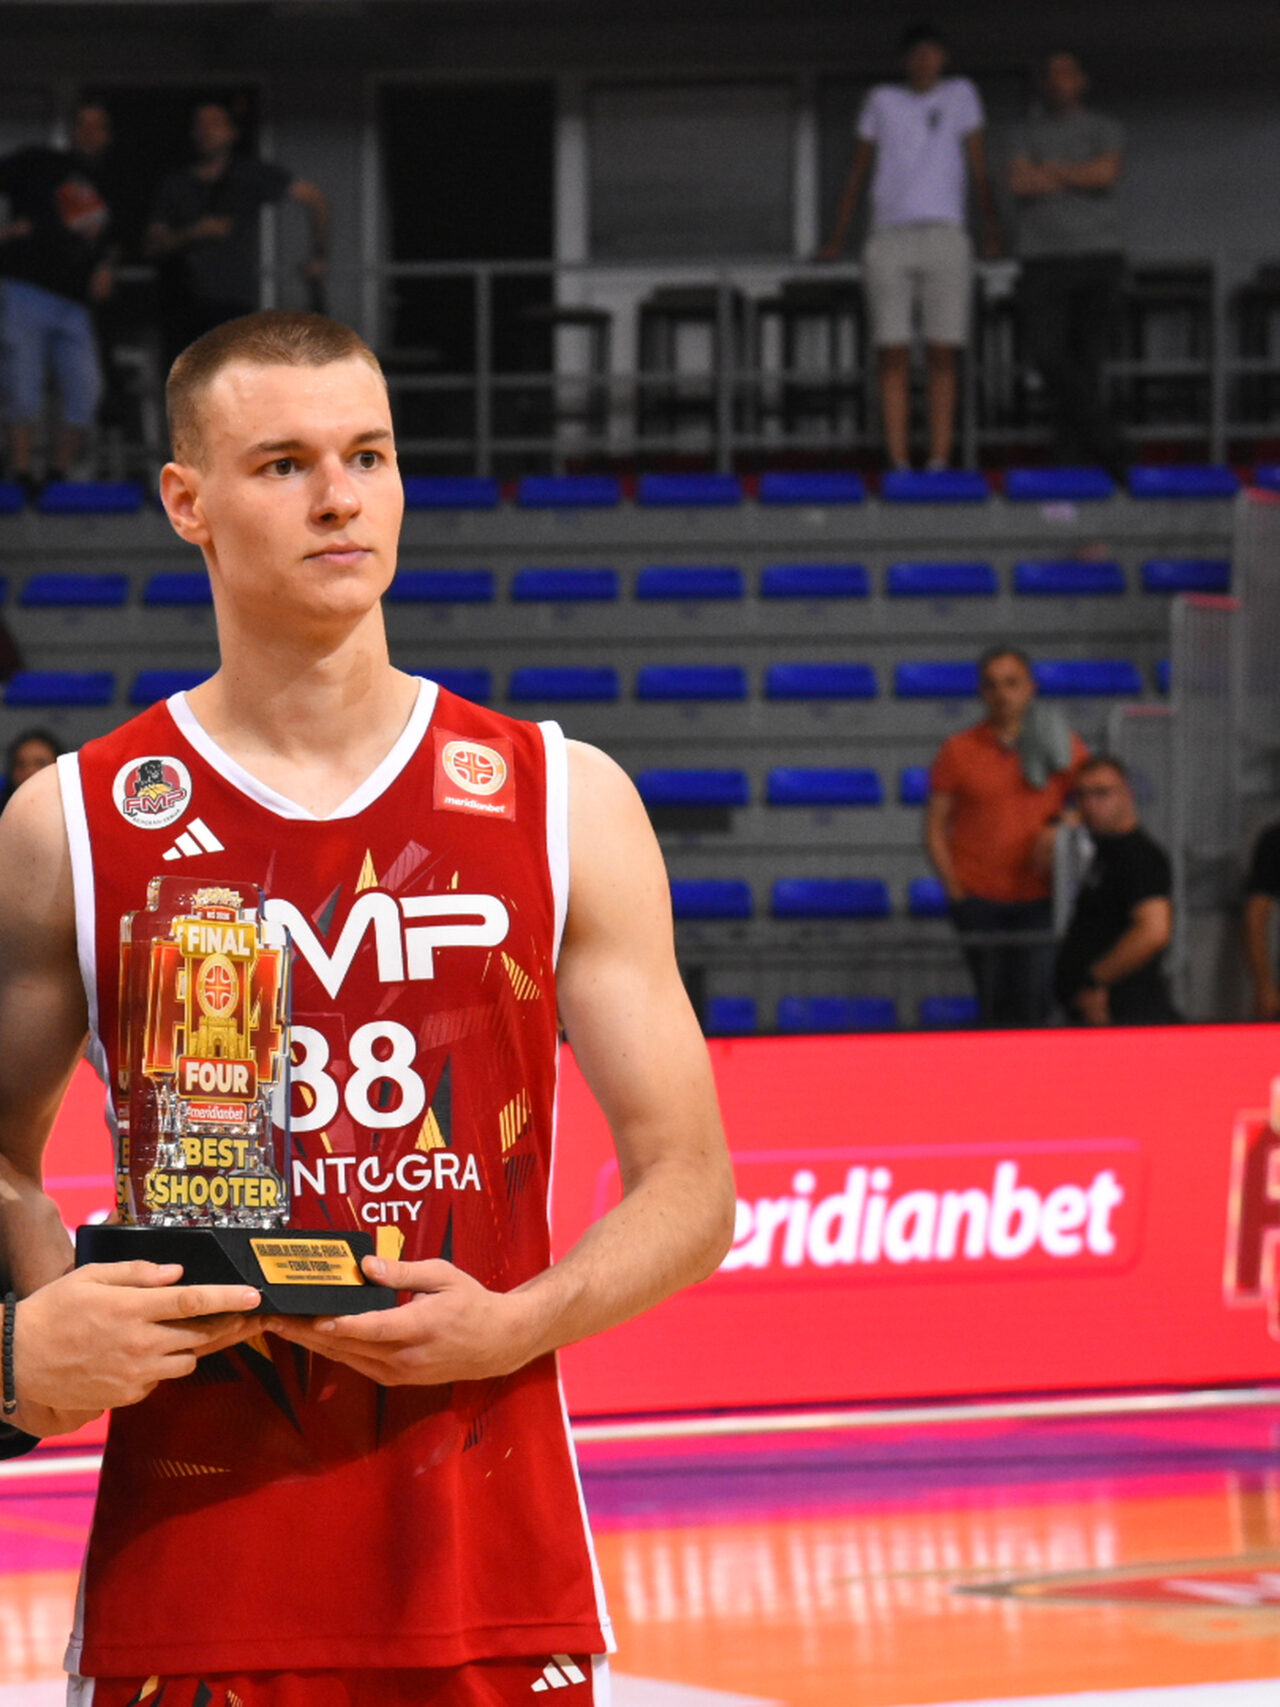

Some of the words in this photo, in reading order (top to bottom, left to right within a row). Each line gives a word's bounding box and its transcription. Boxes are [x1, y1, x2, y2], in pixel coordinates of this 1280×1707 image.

[123, 788, 187, 815] FMP
[444, 797, 506, 813] meridianbet
[187, 926, 251, 956] FINAL
[261, 891, 510, 1000] MP
[185, 1062, 249, 1094] FOUR
[185, 1138, 248, 1168] BEST
[154, 1174, 278, 1207] SHOOTER
[361, 1201, 423, 1223] CITY
